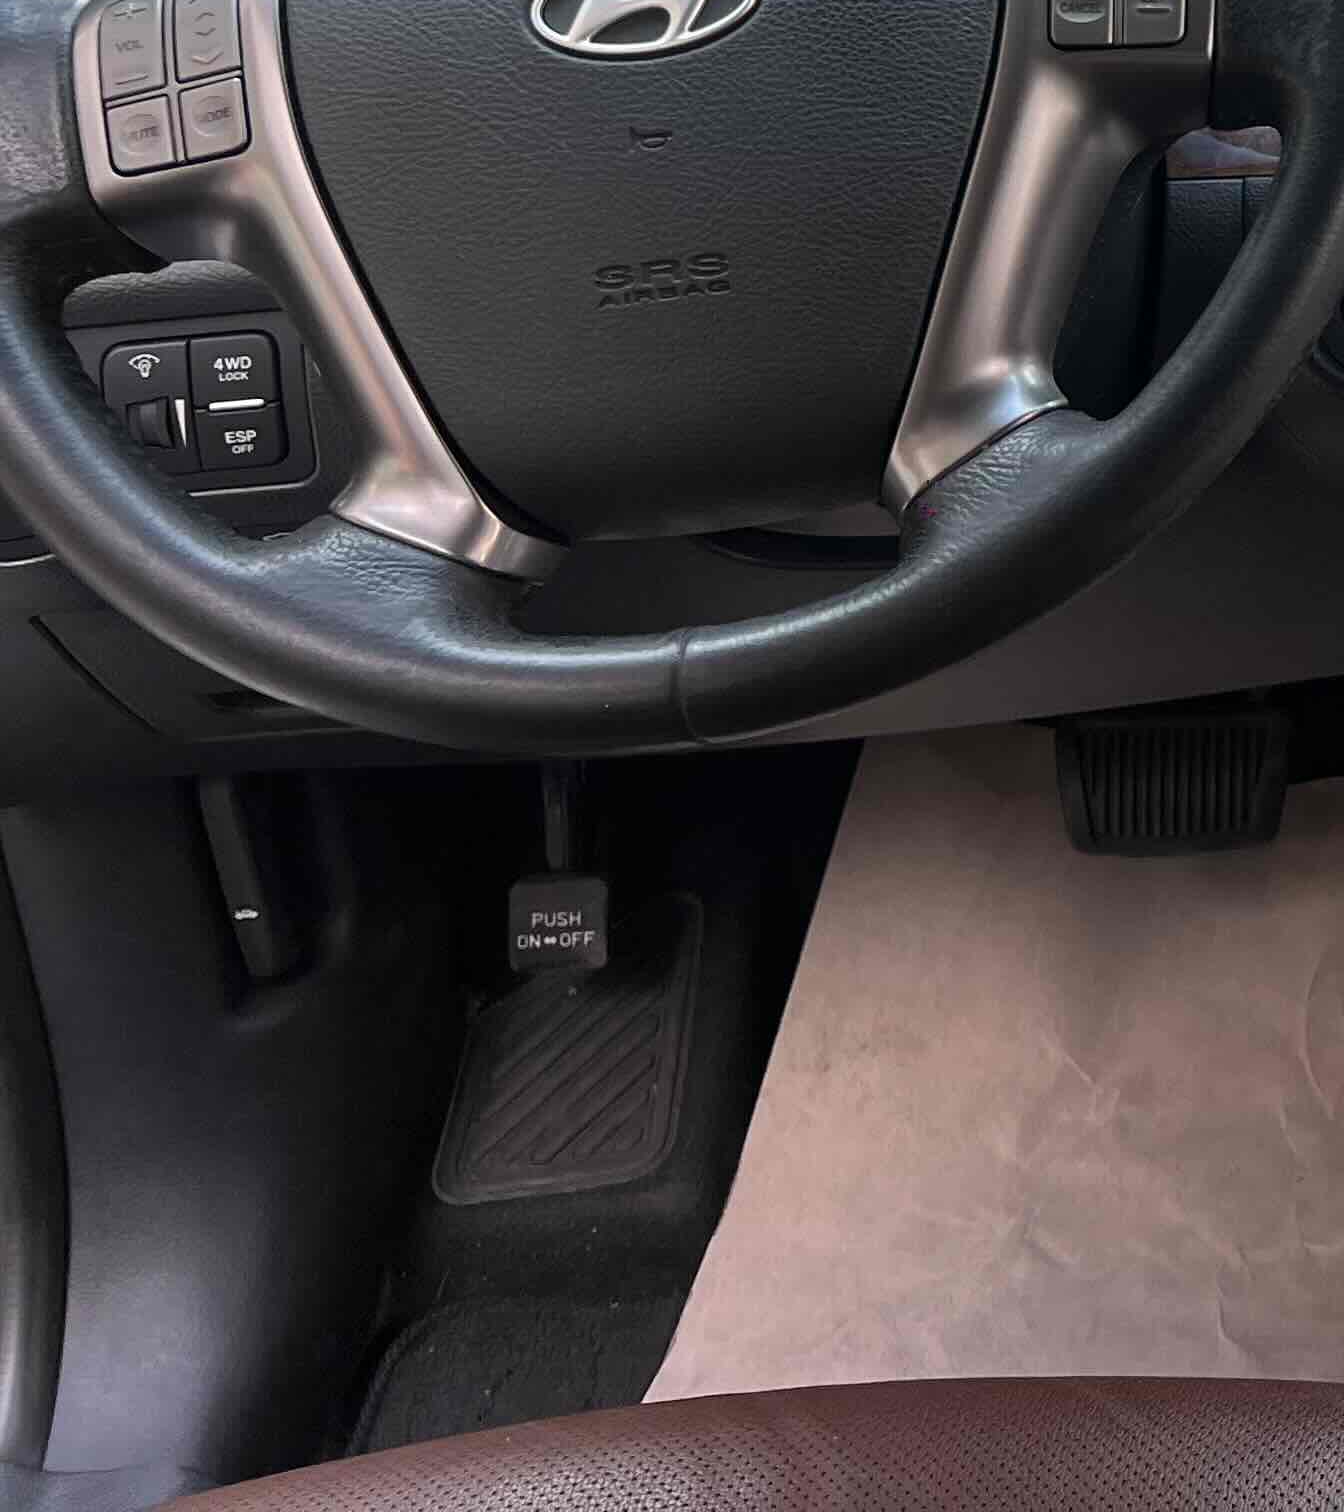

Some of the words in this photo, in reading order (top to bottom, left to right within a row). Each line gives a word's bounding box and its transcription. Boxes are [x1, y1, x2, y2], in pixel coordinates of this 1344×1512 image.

[115, 39, 143, 53] VOL
[593, 251, 730, 293] SRS
[213, 355, 252, 370] 4WD
[218, 371, 249, 382] LOCK
[224, 430, 257, 444] ESP
[231, 444, 254, 455] OFF
[531, 910, 582, 929] PUSH
